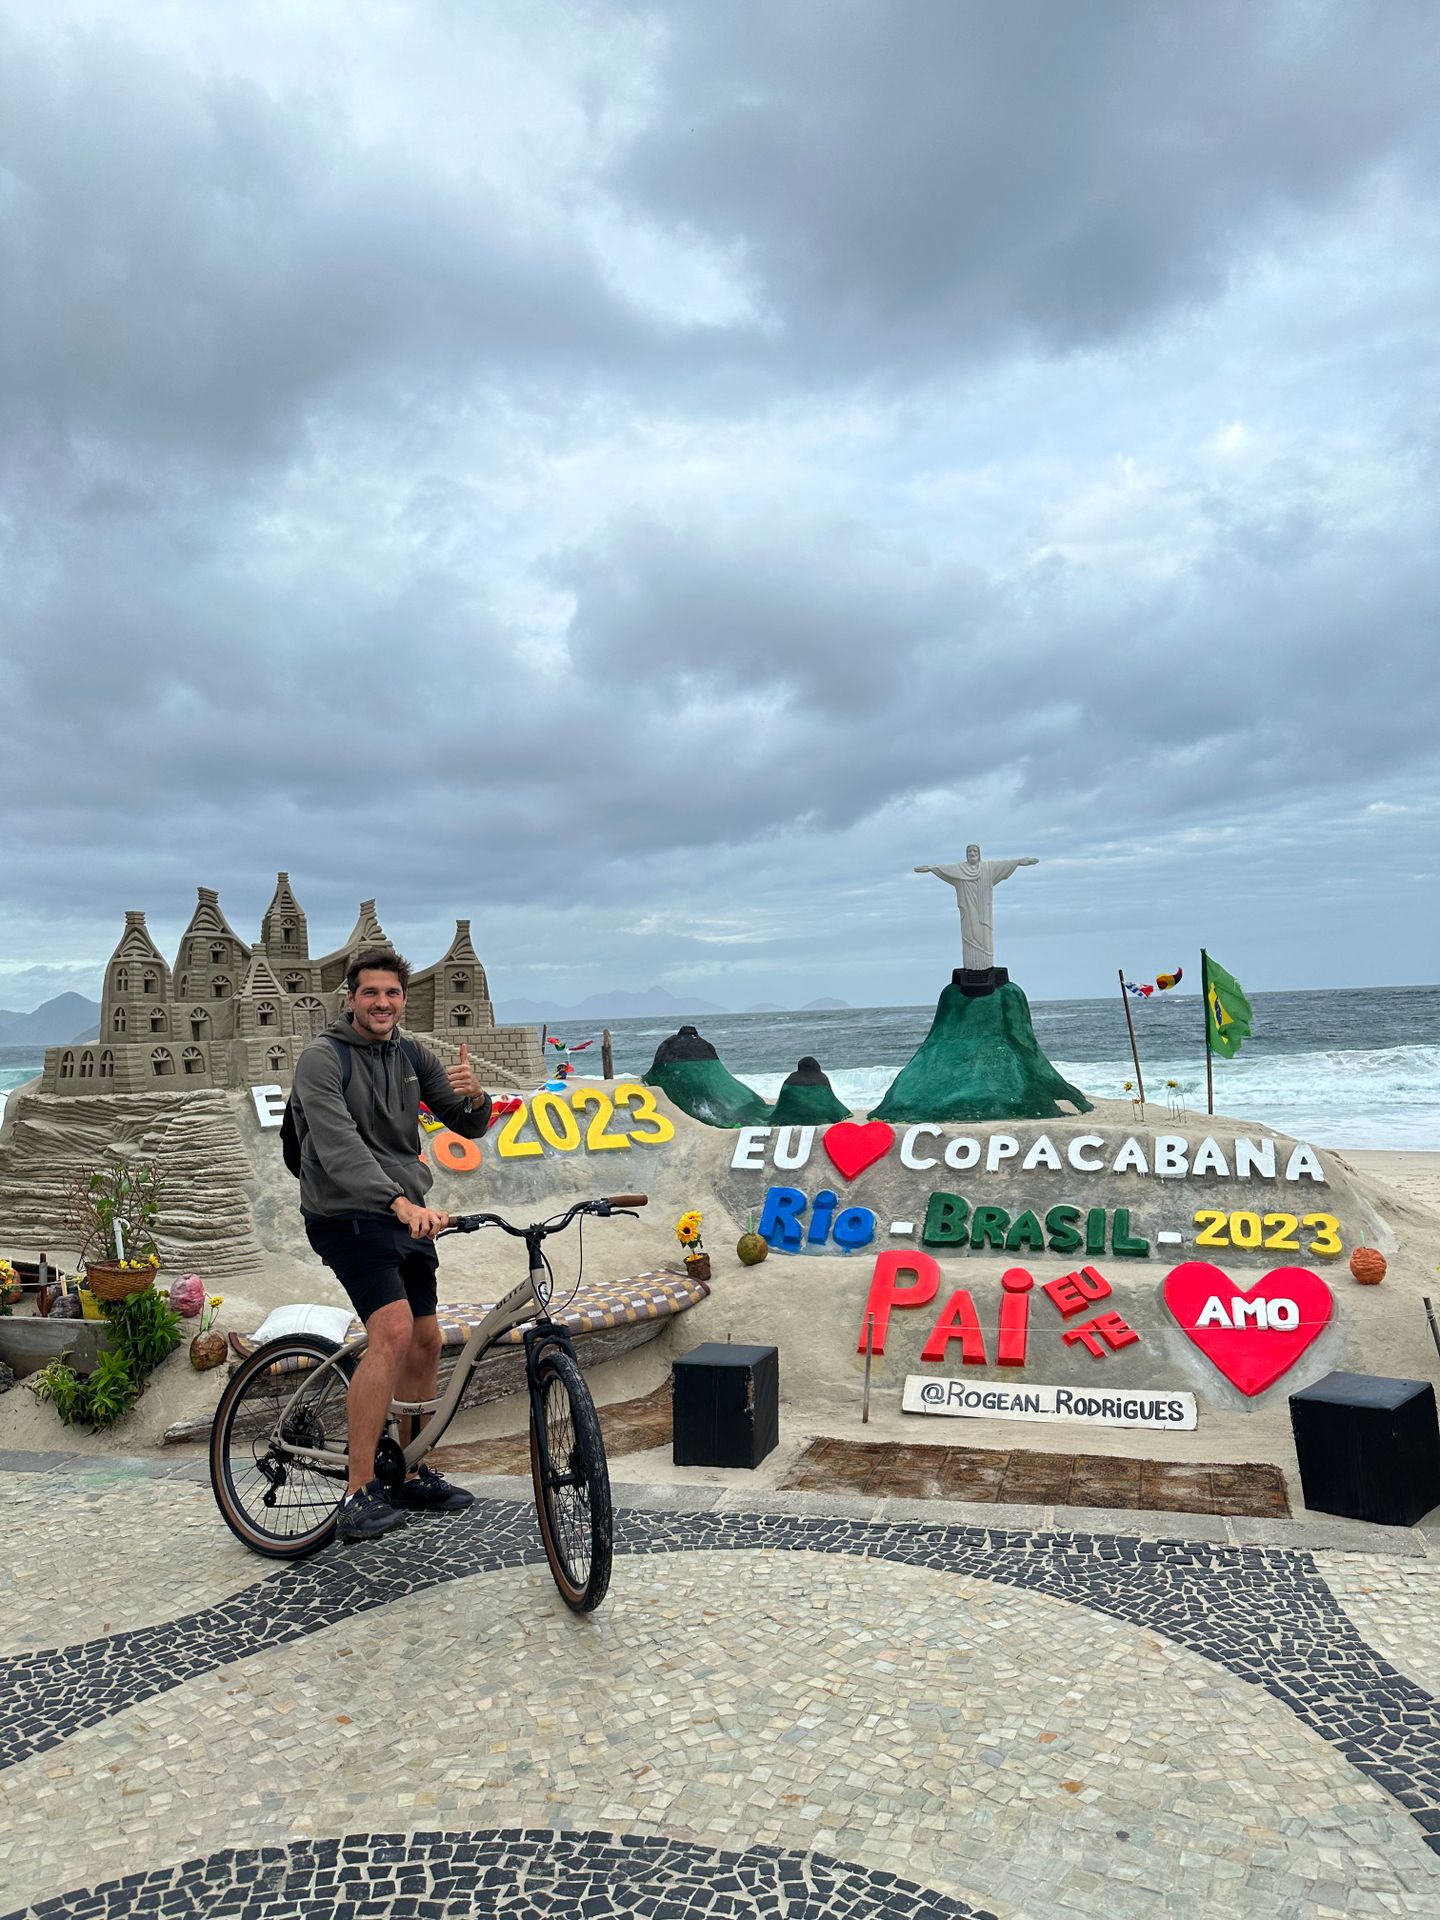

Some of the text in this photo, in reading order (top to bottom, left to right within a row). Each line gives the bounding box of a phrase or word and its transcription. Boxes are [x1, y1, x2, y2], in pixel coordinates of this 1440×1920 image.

[498, 1083, 675, 1157] 2023
[731, 1126, 815, 1169] EU
[922, 1192, 1149, 1256] BRASIL
[1194, 1210, 1342, 1255] 2023
[1042, 1266, 1112, 1318] EU
[1195, 1296, 1299, 1332] AMO
[1062, 1311, 1140, 1358] TE
